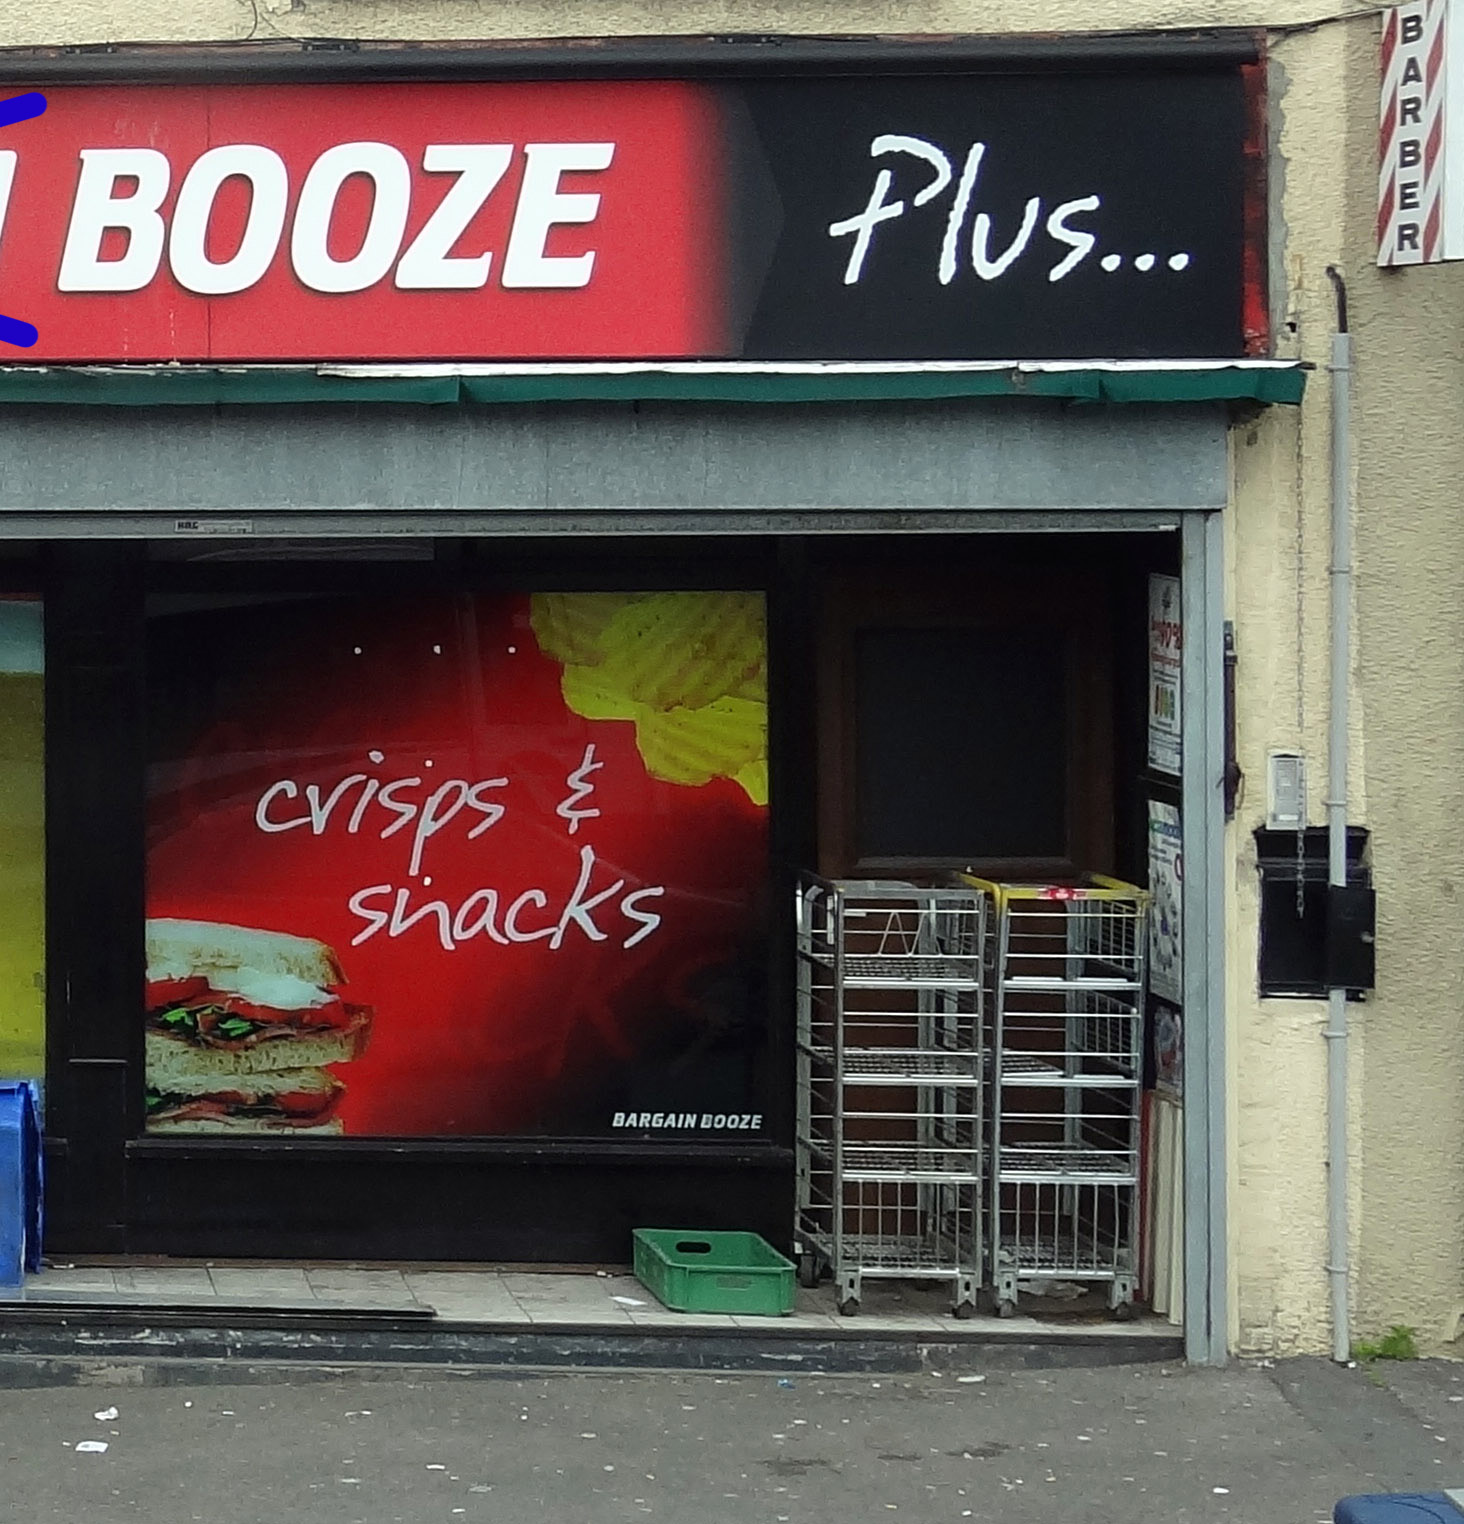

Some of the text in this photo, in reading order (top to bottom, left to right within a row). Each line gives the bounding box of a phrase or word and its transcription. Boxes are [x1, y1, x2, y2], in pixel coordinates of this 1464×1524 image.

[1397, 13, 1424, 252] BARBER
[57, 141, 616, 295] BOOZE
[254, 750, 509, 877] crisps
[347, 846, 665, 951] snacks
[612, 1111, 763, 1132] BARGAIN BOOZE
